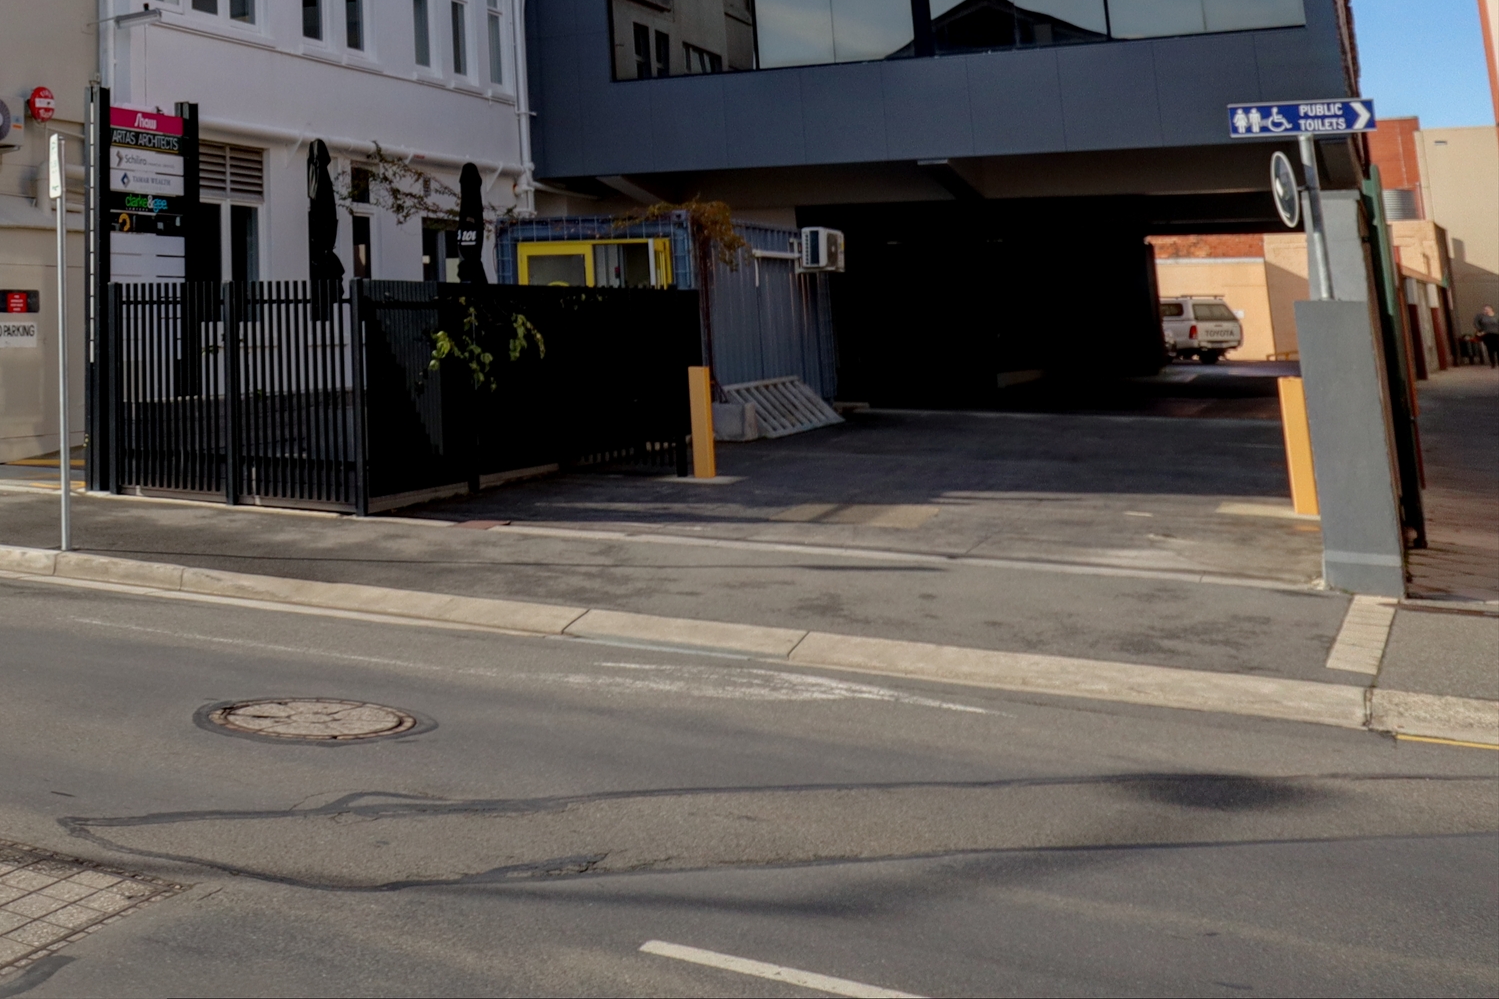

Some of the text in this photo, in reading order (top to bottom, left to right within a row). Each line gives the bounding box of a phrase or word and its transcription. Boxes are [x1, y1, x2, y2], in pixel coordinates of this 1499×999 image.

[1298, 103, 1343, 117] PUBLIC
[134, 113, 157, 130] Shaw
[1298, 117, 1346, 131] TOILETS
[112, 130, 179, 150] ARTAS ARCHITECTS
[3, 325, 35, 337] PARKING
[1205, 329, 1235, 338] TOYOTA
